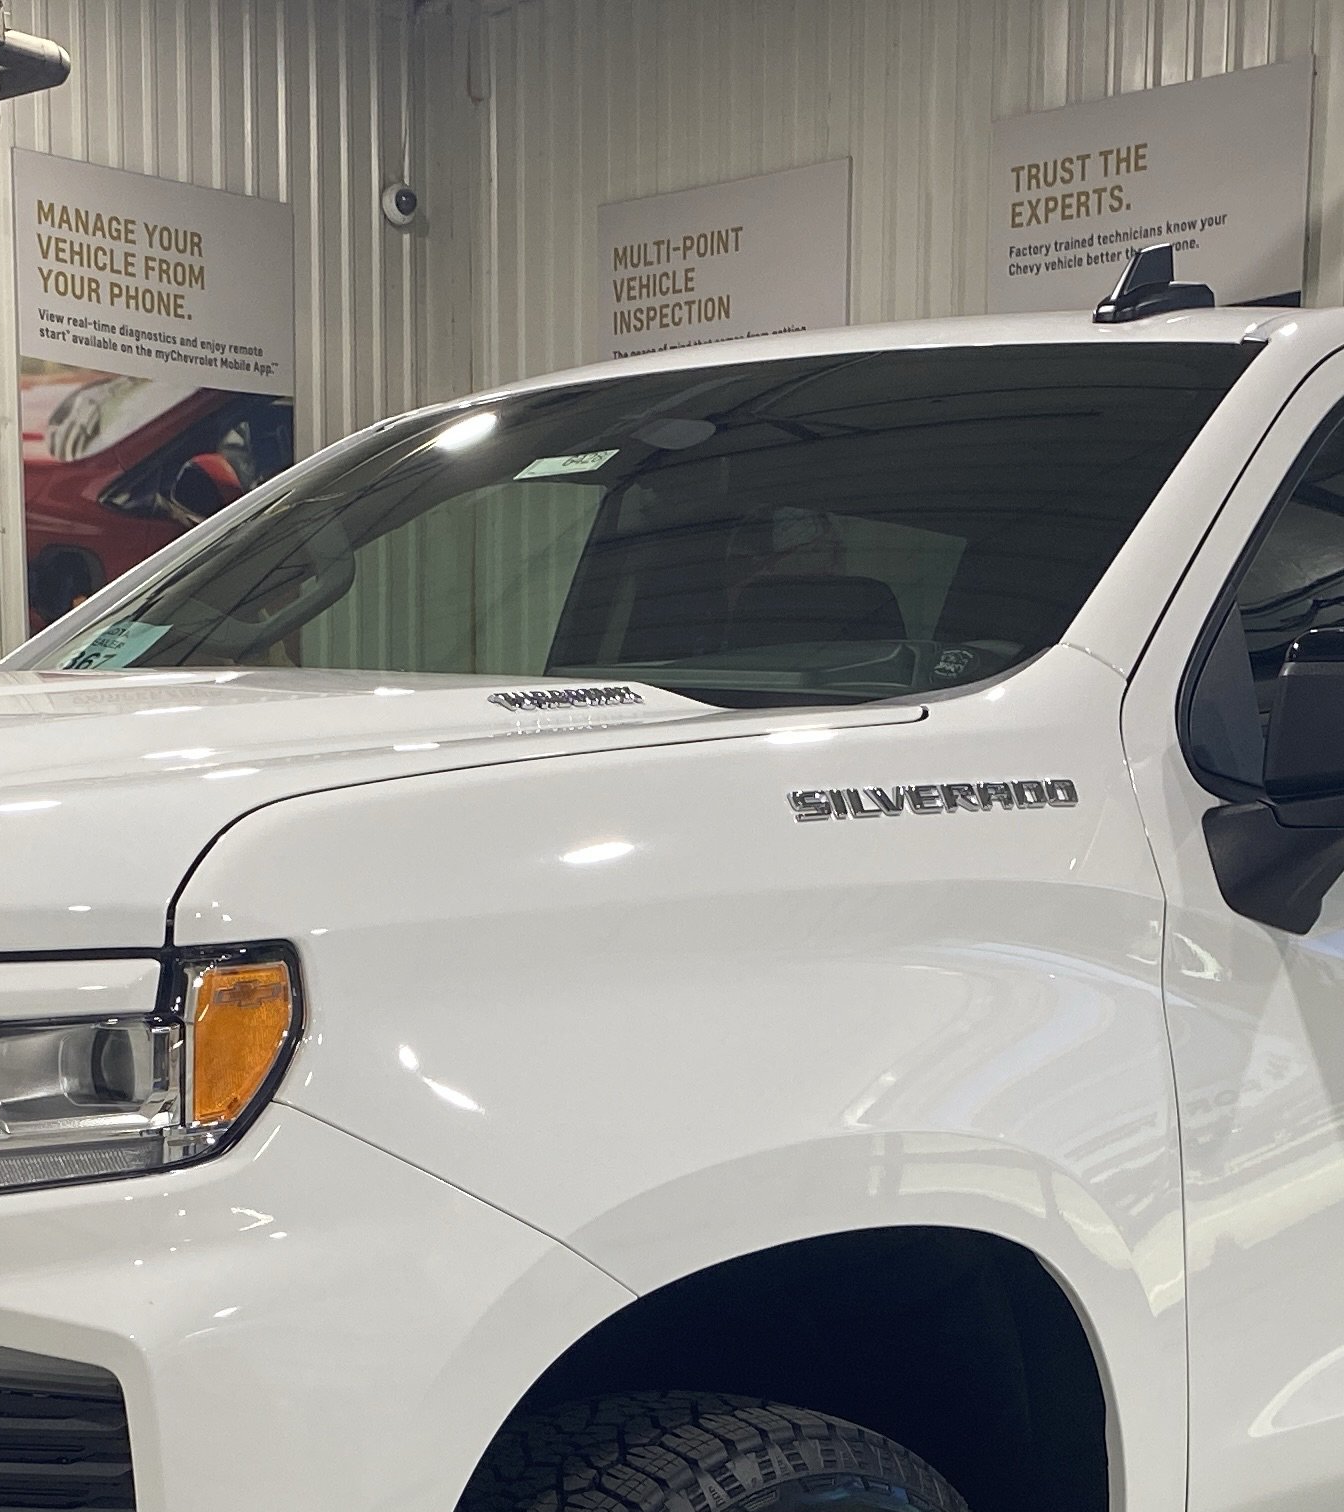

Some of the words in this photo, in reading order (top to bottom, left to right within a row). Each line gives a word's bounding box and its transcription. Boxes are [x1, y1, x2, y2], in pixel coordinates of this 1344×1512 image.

[1010, 154, 1091, 193] TRUST
[1099, 143, 1148, 177] THE
[37, 200, 137, 245] MANAGE
[143, 222, 204, 258] YOUR
[1010, 185, 1132, 229] EXPERTS.
[613, 226, 744, 272] MULTI-POINT
[1009, 242, 1051, 259] Factory
[1054, 234, 1094, 253] trained
[1097, 225, 1163, 246] technicians
[1166, 220, 1197, 234] know
[1200, 214, 1228, 232] your
[37, 233, 137, 278] VEHICLE
[144, 255, 206, 291] FROM
[1009, 261, 1042, 277] Chevy
[1044, 255, 1083, 273] vehicle
[1086, 250, 1122, 266] better
[38, 266, 101, 305] YOUR
[110, 281, 192, 320] PHONE.
[613, 267, 695, 303] VEHICLE
[38, 307, 64, 324] View
[67, 315, 116, 335] real-time
[119, 324, 177, 346] diagnostics
[180, 336, 197, 348] and
[200, 340, 226, 355] enjoy
[229, 345, 263, 357] remote
[613, 294, 731, 335] INSPECTION
[72, 335, 118, 352] available
[121, 344, 133, 354] on
[136, 345, 152, 357] the
[155, 350, 218, 368] myChevrolet
[220, 357, 251, 372] Mobile
[787, 778, 1079, 823] SILVERADO
